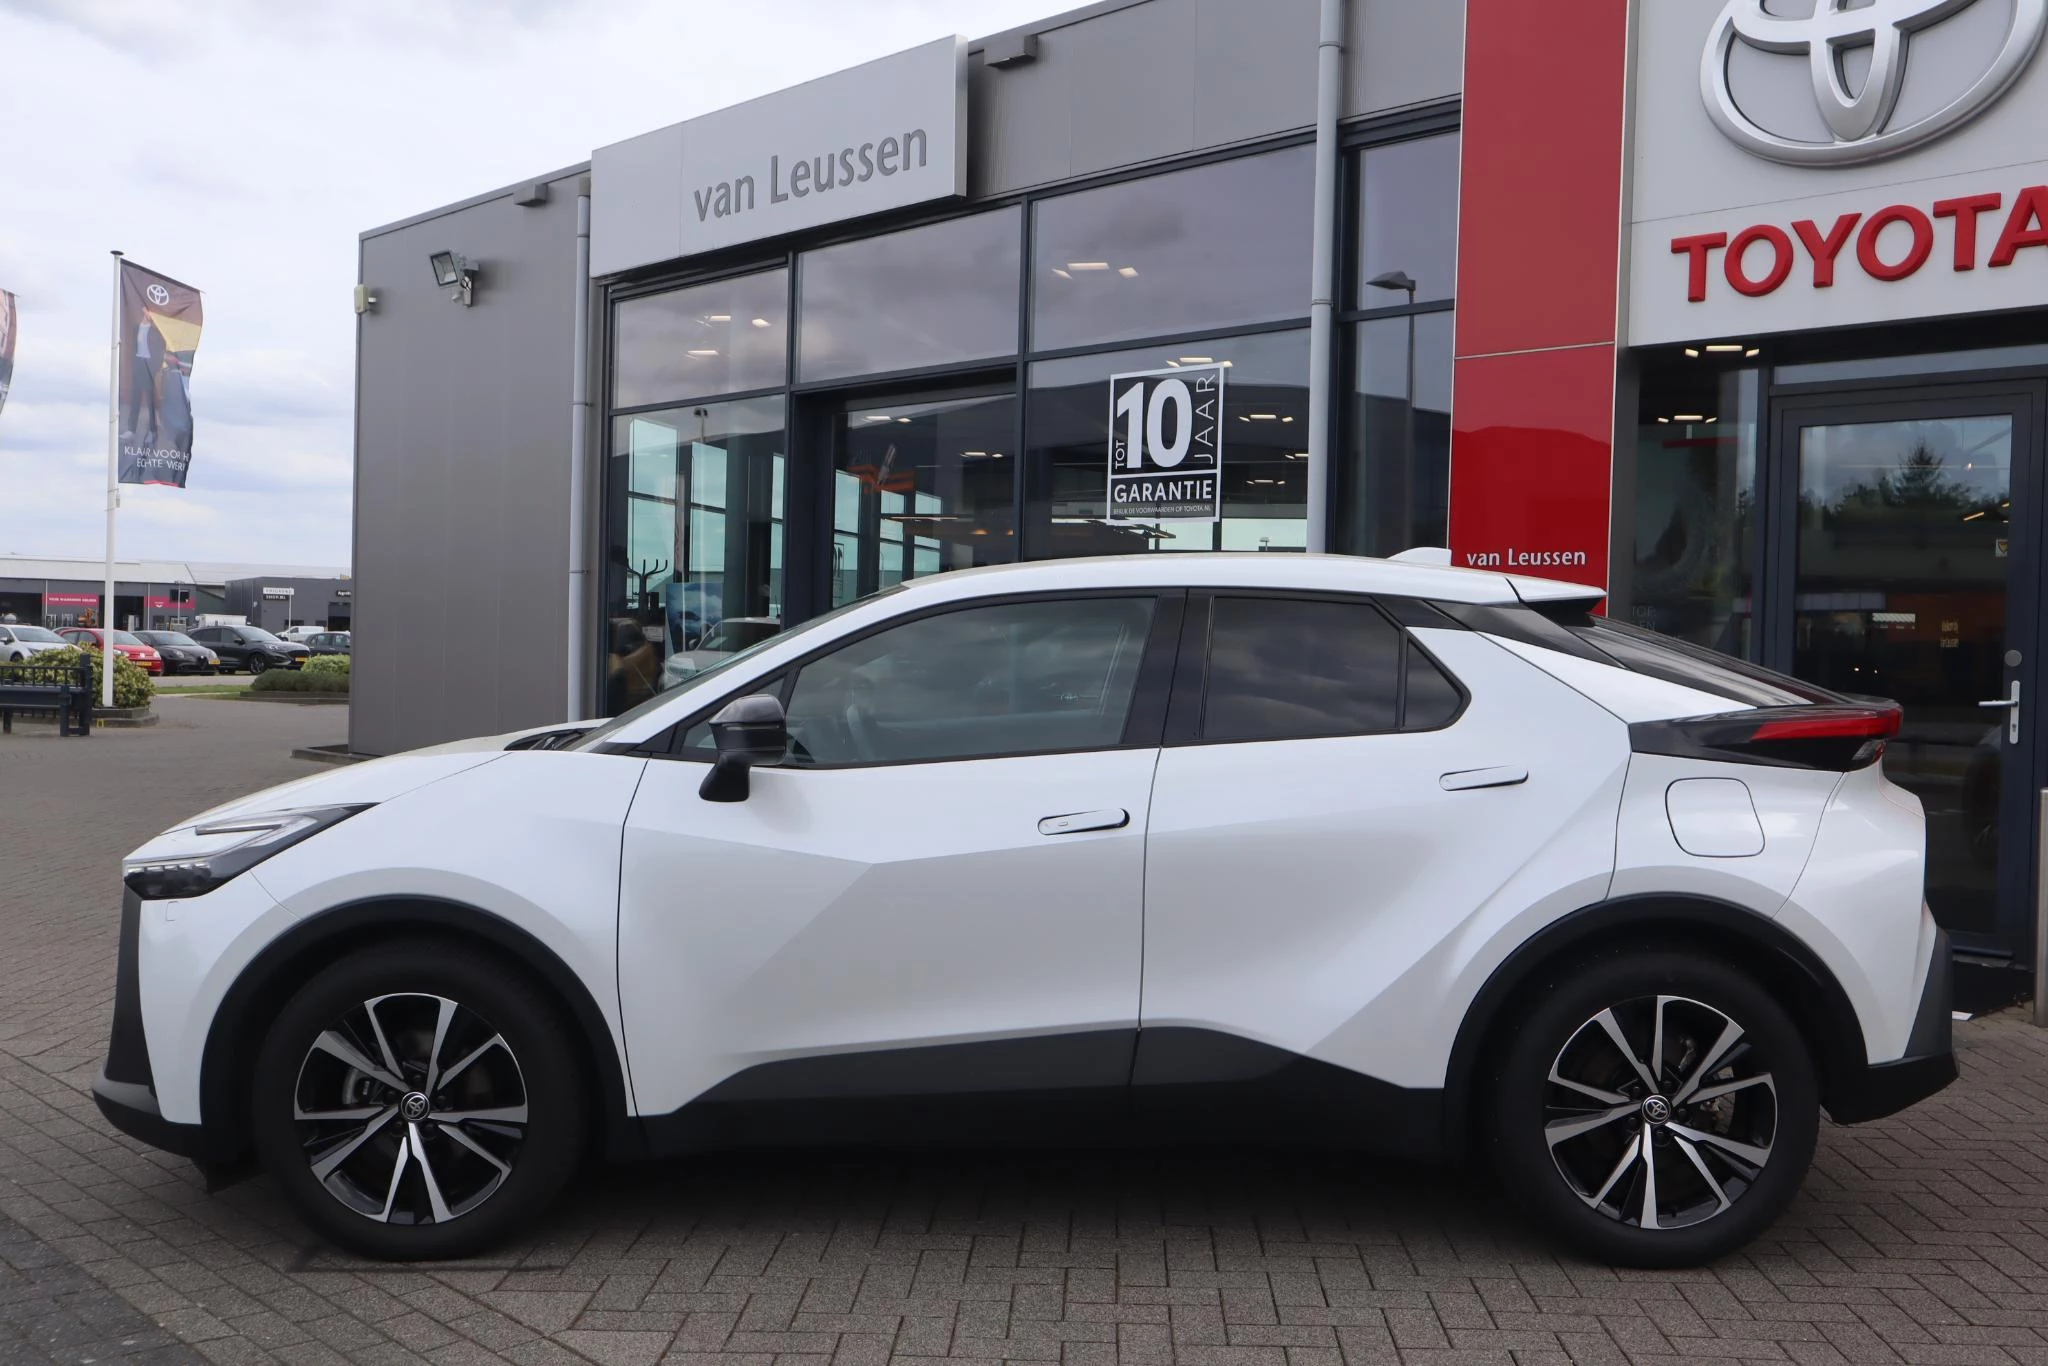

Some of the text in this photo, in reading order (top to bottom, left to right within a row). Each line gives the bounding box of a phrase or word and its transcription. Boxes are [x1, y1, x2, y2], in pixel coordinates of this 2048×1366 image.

[693, 128, 927, 221] van Leussen
[1671, 185, 2048, 303] TOYOTA
[1115, 439, 1126, 470] TOT
[1116, 378, 1193, 469] 10
[1194, 373, 1216, 465] JAAR
[1114, 480, 1213, 504] GARANTIE
[1466, 548, 1587, 566] van Leussen
